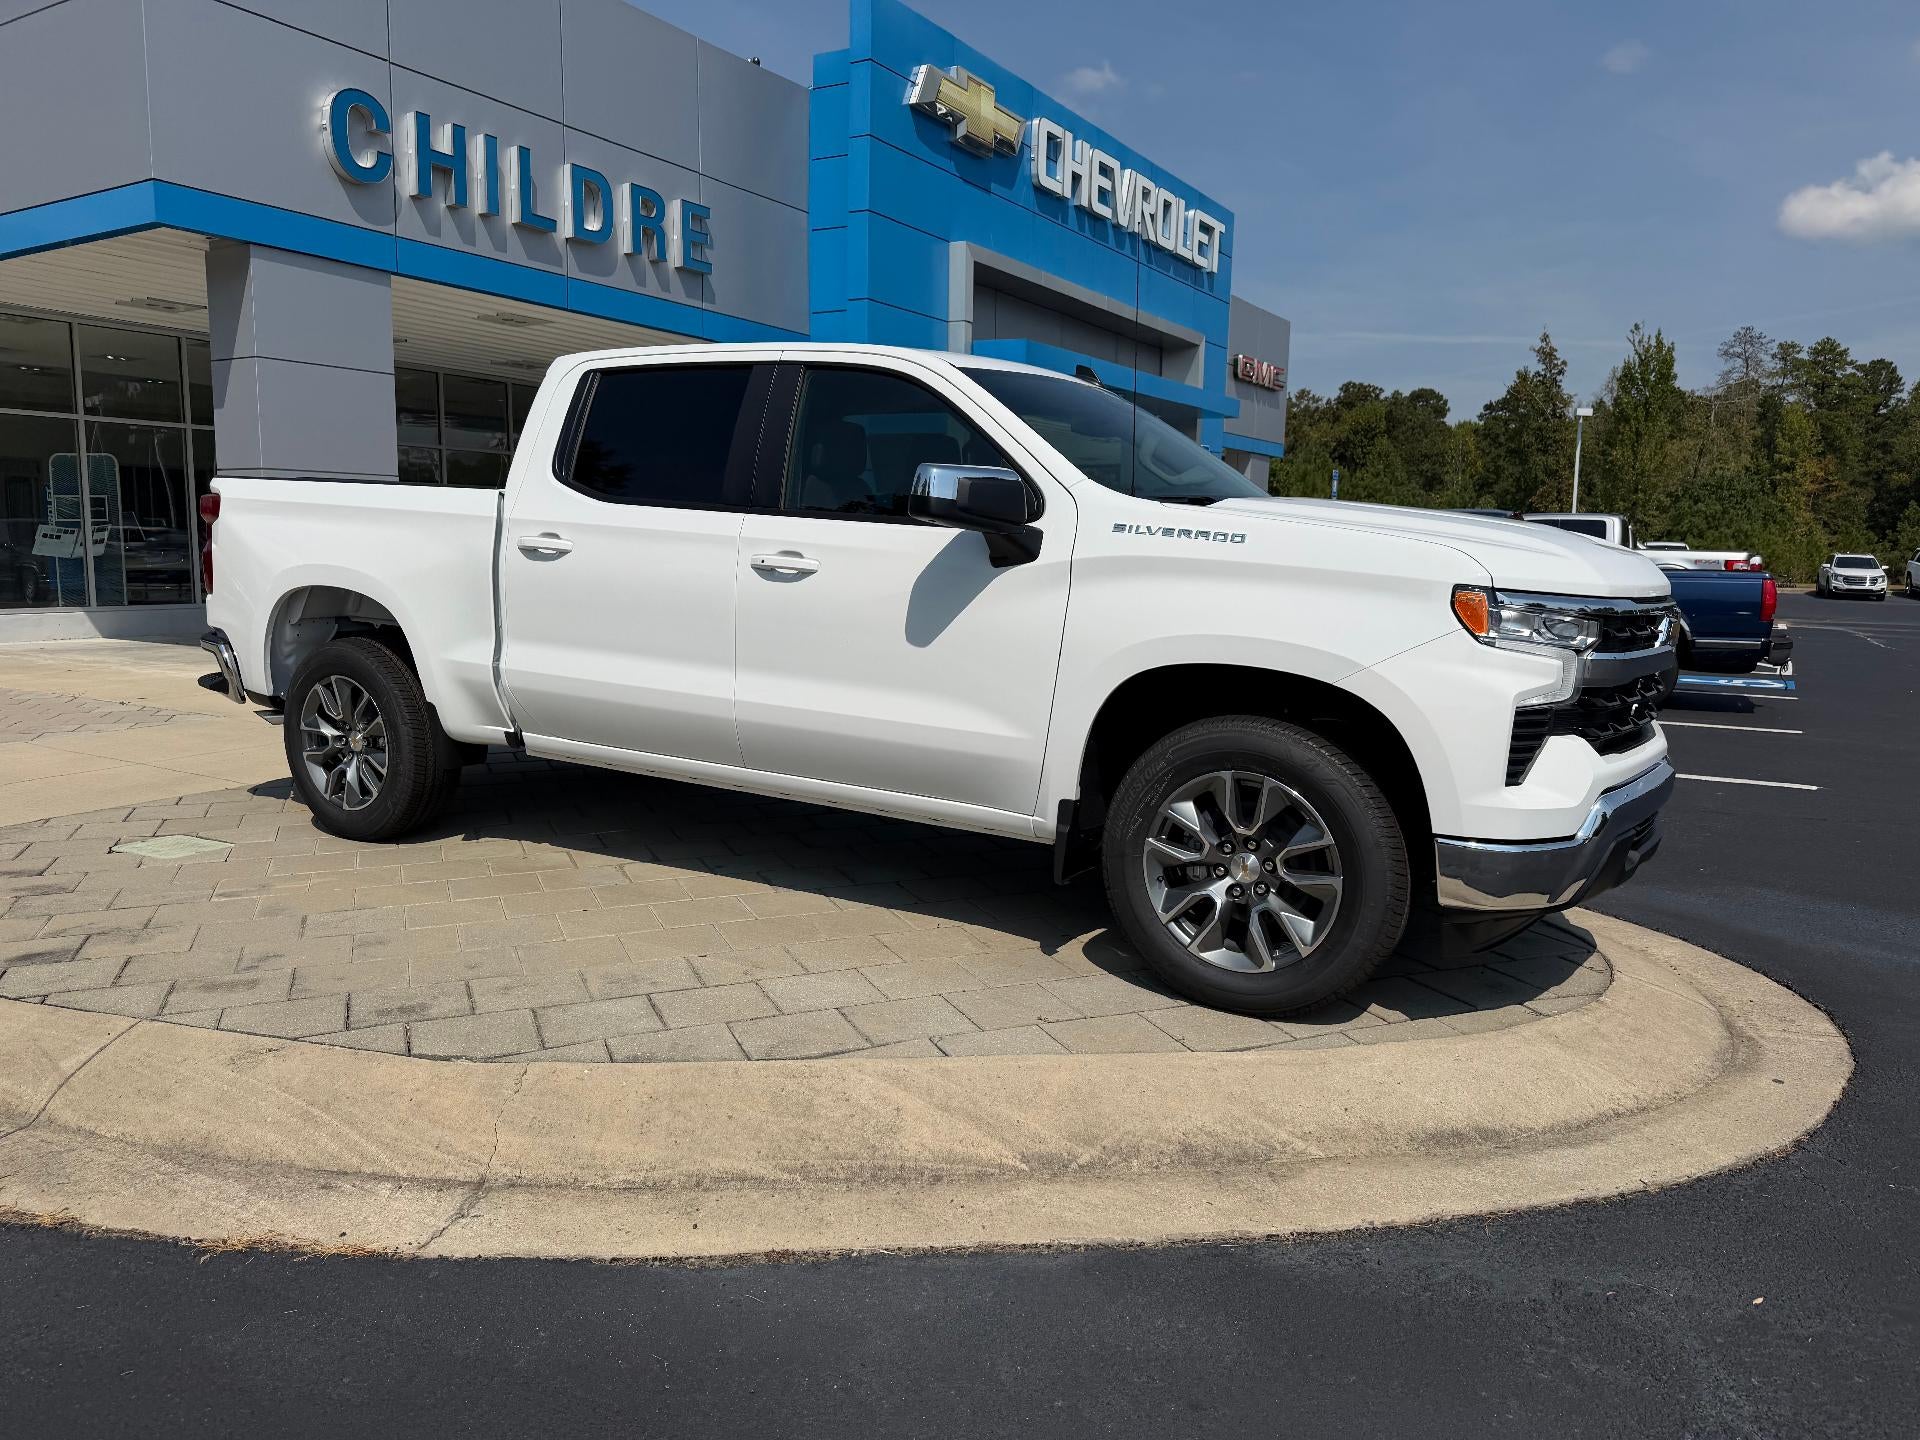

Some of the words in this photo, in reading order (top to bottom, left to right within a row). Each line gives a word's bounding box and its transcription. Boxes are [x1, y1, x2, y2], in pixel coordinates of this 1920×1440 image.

[321, 87, 713, 275] CHILDRE
[1031, 116, 1226, 273] CHEVROLET
[1233, 354, 1287, 391] GMC
[1111, 522, 1247, 544] SILVERADO
